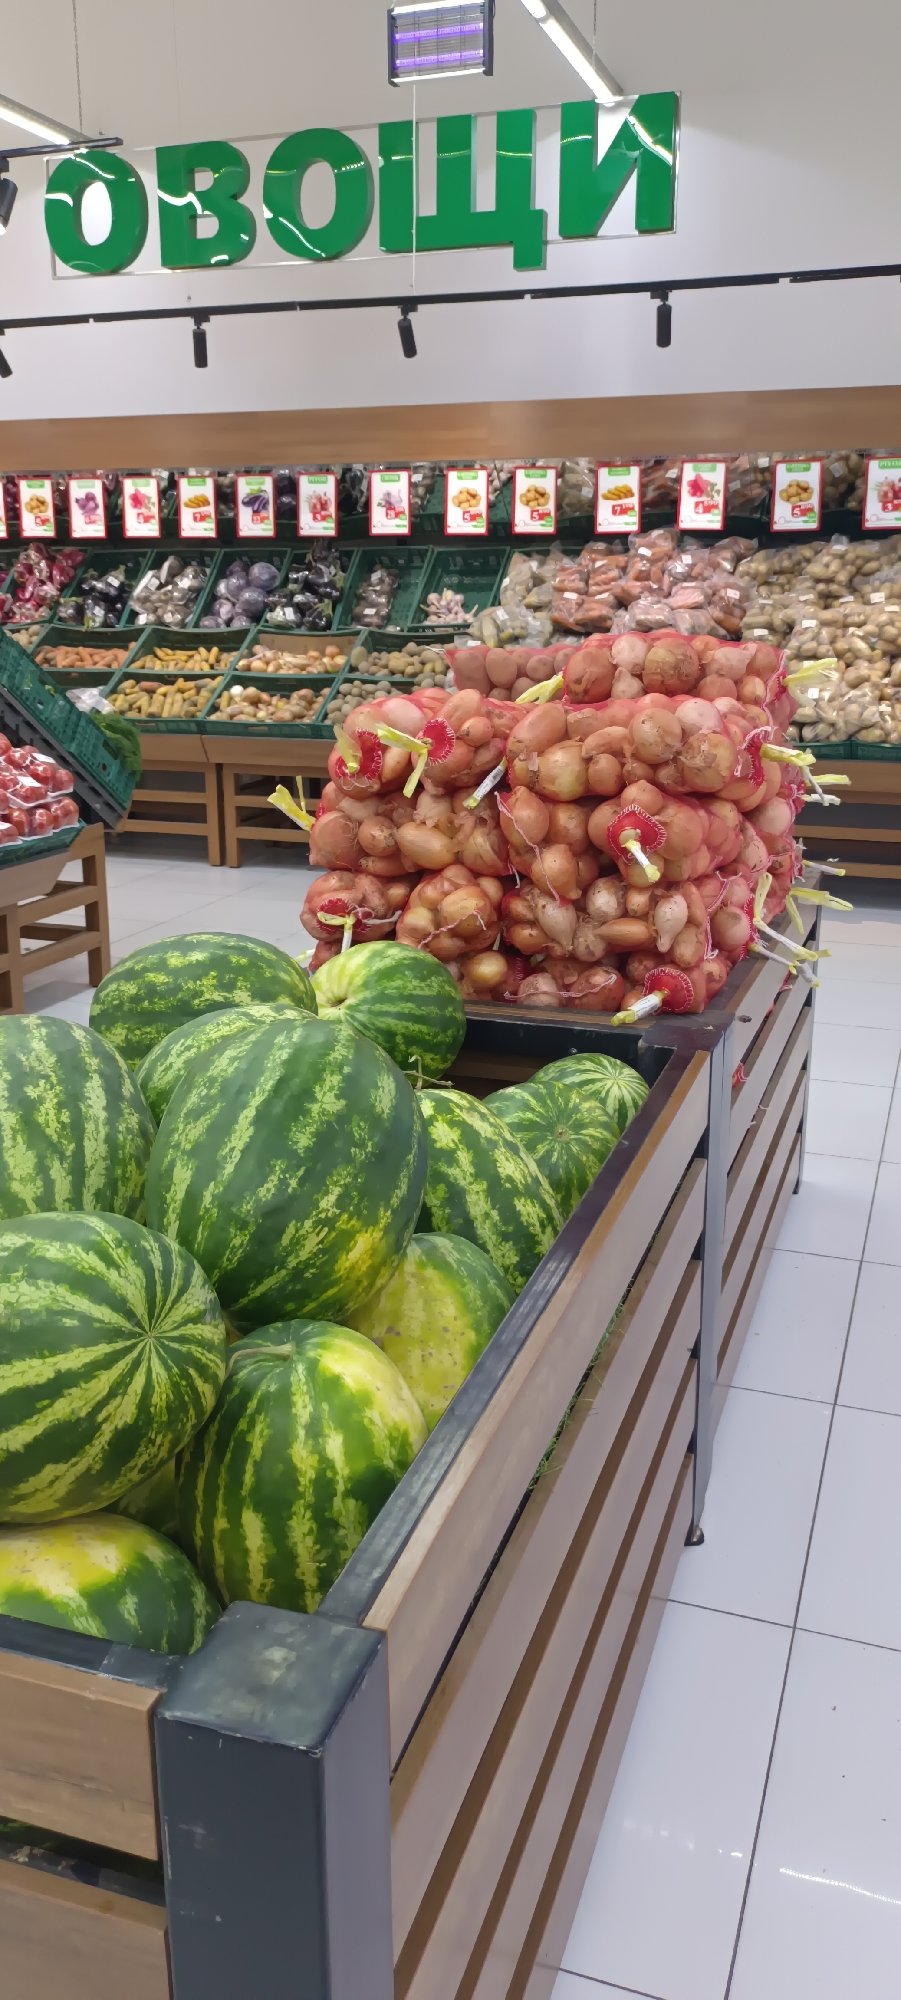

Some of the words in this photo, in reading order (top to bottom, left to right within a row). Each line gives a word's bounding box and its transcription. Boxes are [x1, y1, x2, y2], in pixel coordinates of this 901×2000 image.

[44, 91, 678, 275] ОВОЩИ
[614, 506, 621, 516] 7
[695, 502, 703, 513] 4
[793, 507, 801, 517] 5
[884, 503, 892, 512] 3
[194, 513, 201, 522] 7
[464, 512, 471, 522] 5
[532, 511, 539, 521] 5
